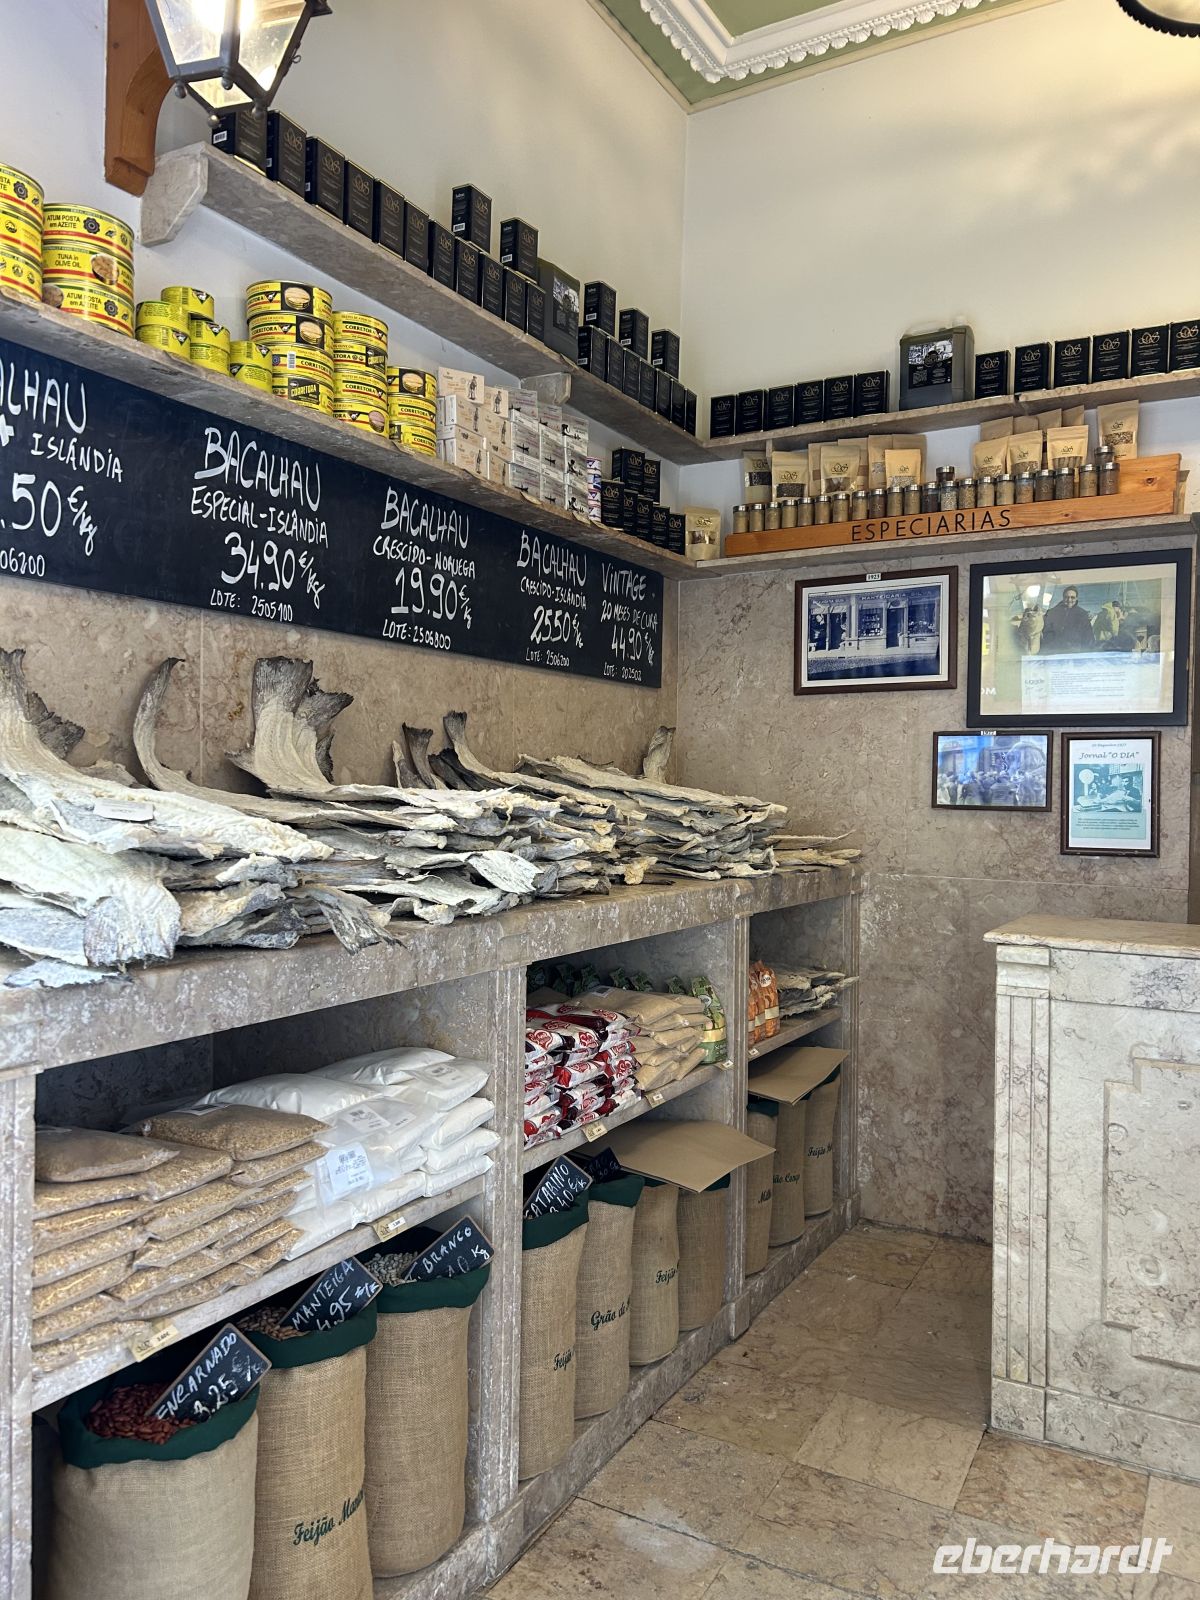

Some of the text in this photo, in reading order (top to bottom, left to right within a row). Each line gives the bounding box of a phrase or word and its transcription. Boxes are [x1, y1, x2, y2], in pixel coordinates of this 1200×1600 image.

[344, 324, 376, 334] CORRETORA
[344, 383, 376, 394] CORRETORA
[400, 406, 428, 416] CORRETORA
[194, 427, 321, 512] BACALHAU
[380, 486, 470, 549] BACALHAU
[852, 510, 1011, 542] ESPECIARIAS
[221, 532, 296, 592] 34.90
[517, 530, 587, 587] BACALHAU
[391, 566, 458, 620] 19.90
[602, 562, 647, 601] VINTAGE
[210, 588, 294, 622] LOTE: 2505100
[600, 600, 658, 634] 20 MESES DE CURA
[1079, 752, 1106, 760] Jornal
[422, 1226, 472, 1274] BRANCO
[292, 1260, 354, 1330] MANTEIGA
[590, 1310, 616, 1331] Grão
[293, 1512, 336, 1546] Feijão
